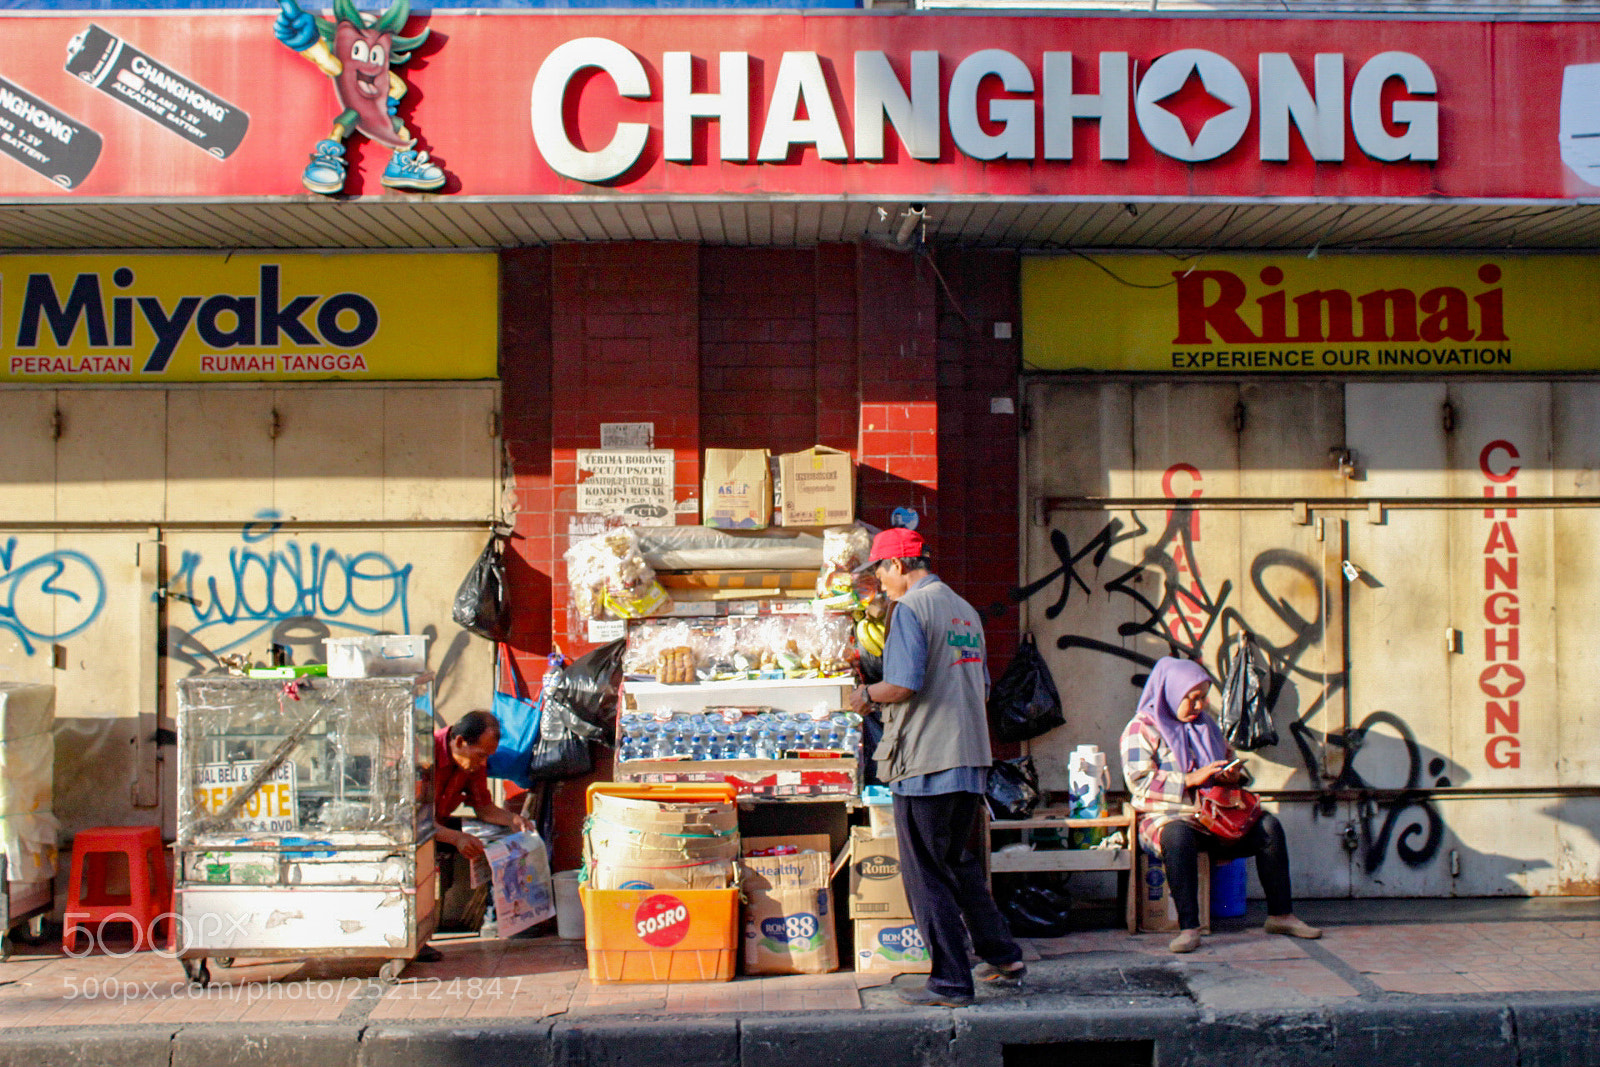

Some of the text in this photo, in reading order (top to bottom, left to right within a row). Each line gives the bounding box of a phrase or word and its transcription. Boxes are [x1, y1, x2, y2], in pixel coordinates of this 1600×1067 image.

[131, 56, 226, 123] CHANGHONG
[0, 87, 73, 144] NGHONG
[111, 82, 207, 139] ALKALINE BATTERY
[181, 109, 201, 125] 1.5V
[531, 37, 1439, 183] CHANGHONG
[1, 132, 51, 164] BATTERY
[18, 129, 43, 147] 1.5V
[1171, 263, 1510, 345] Rinnai
[16, 264, 379, 373] Miyako
[10, 354, 367, 374] PERALATAN RUMAH TANGGA
[1172, 348, 1512, 369] EXPERIENCE OUR INNOVATION
[585, 455, 666, 464] TERIMA BORONG
[630, 487, 665, 496] RUSAK
[1479, 439, 1526, 769] CHANGHONG
[218, 767, 238, 783] BELI
[241, 766, 248, 782] &
[270, 819, 293, 832] DVD
[756, 863, 805, 877] Healthy
[862, 861, 898, 875] Roma
[637, 905, 687, 938] SOSRO
[765, 915, 815, 938] RON 88
[882, 927, 925, 948] RON 88
